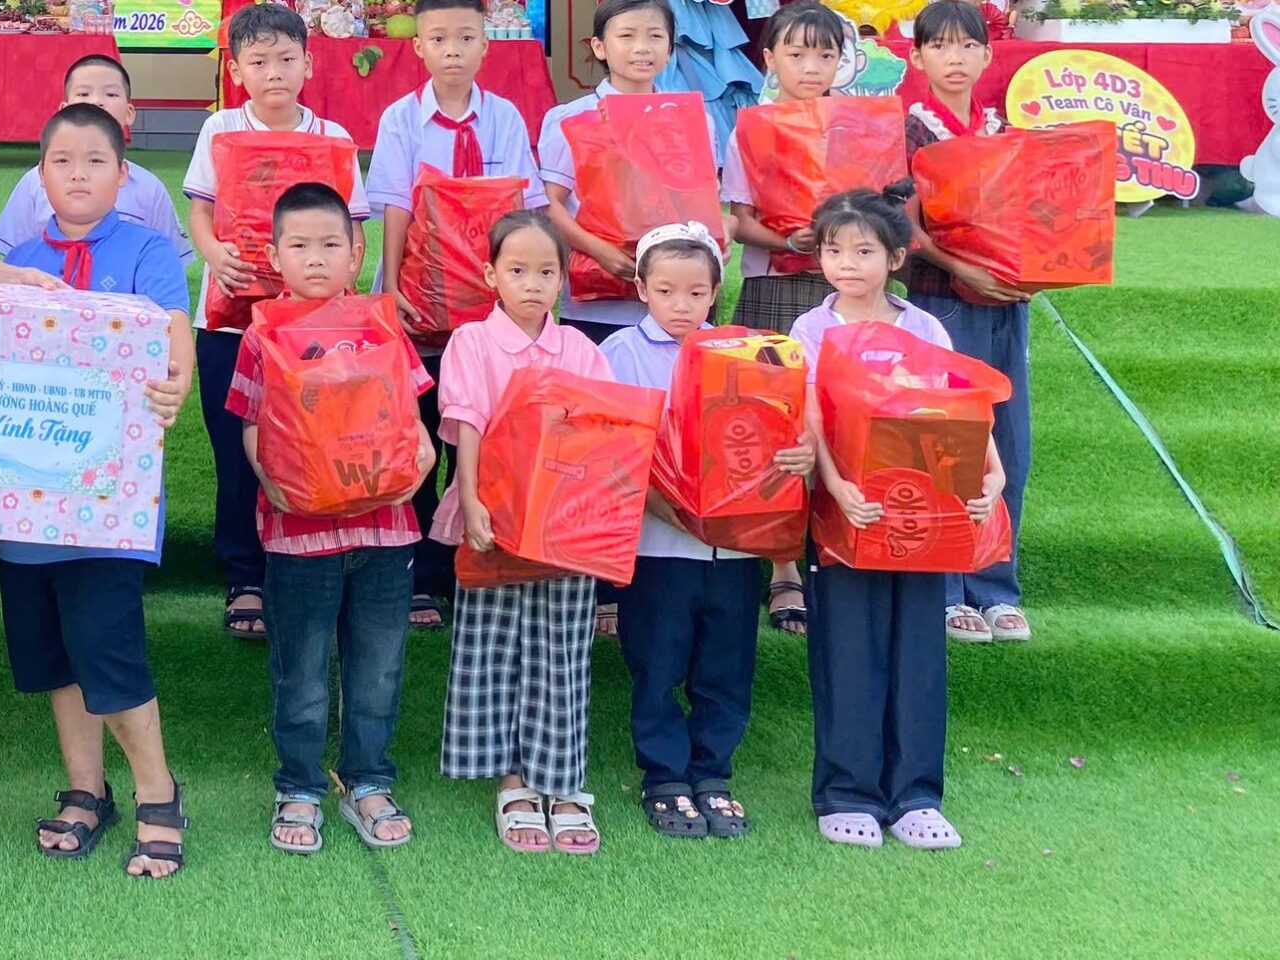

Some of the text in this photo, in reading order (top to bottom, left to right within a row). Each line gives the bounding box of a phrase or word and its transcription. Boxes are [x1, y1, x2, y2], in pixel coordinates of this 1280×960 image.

[129, 12, 166, 31] 2026
[1044, 66, 1141, 99] Lớp 4D3
[1042, 95, 1151, 121] Team Cô Vân
[1120, 121, 1169, 161] ẾT
[1132, 157, 1197, 197] THU
[28, 397, 69, 415] HOÀNG
[71, 400, 97, 418] QUẾ
[38, 418, 94, 454] Tặng
